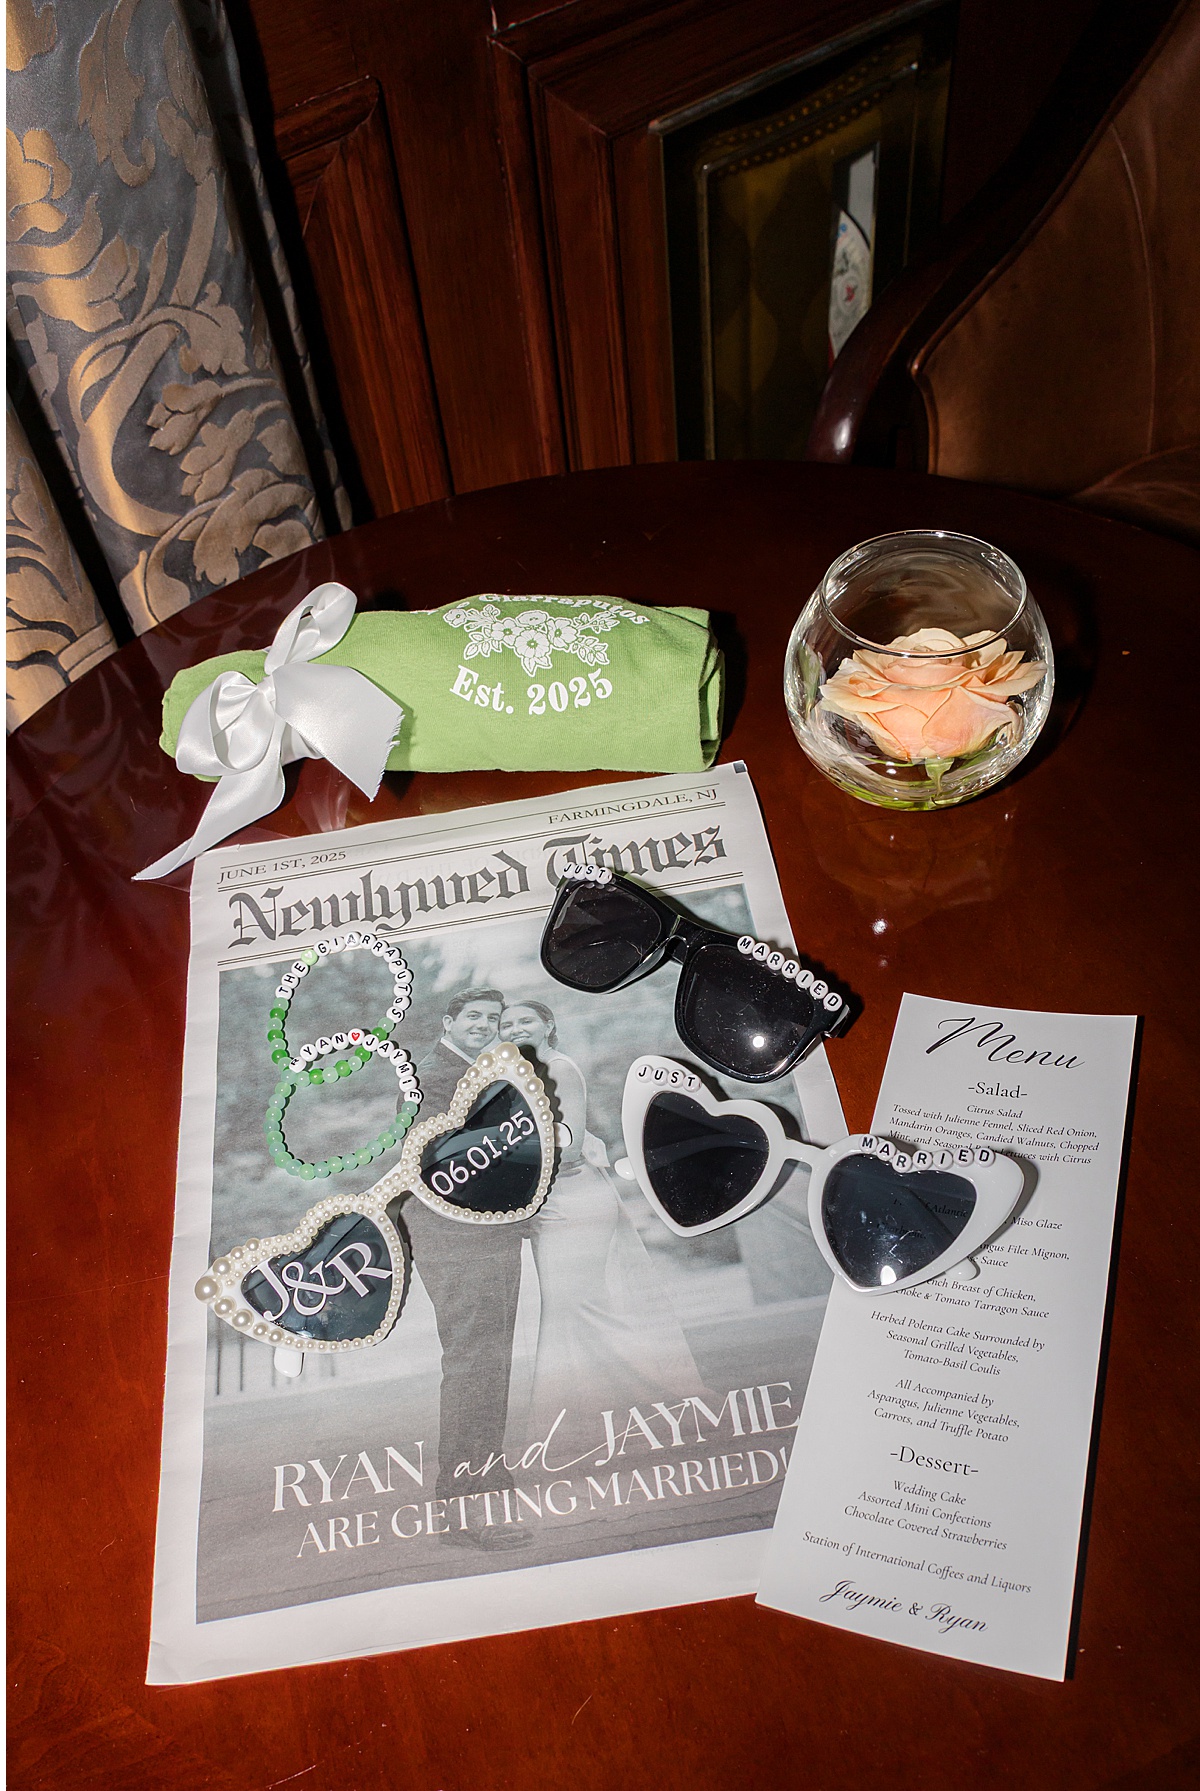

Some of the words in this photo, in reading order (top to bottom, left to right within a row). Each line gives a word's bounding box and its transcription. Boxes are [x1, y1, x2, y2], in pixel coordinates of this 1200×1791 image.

[449, 664, 514, 715] Est.
[526, 667, 613, 716] 2025
[548, 793, 693, 824] FARMINGDALE,
[696, 788, 718, 801] NJ
[217, 865, 267, 885] JUNE
[272, 858, 306, 872] 1ST,
[310, 851, 347, 866] 2025
[564, 864, 607, 880] JUST
[228, 849, 531, 949] Newlywed
[542, 825, 728, 889] Times
[279, 962, 306, 994] THE
[317, 933, 408, 1019] GIARRAPUTOS
[739, 937, 839, 1006] MARRIED
[926, 1017, 1085, 1069] Menu
[291, 1034, 345, 1066] RYAN
[365, 1036, 420, 1100] JAYMIE
[638, 1066, 696, 1087] JUST
[893, 1104, 921, 1117] Tossed
[923, 1109, 942, 1122] with
[943, 1112, 979, 1127] Julienne
[982, 1119, 1014, 1132] Fennel,
[1017, 1123, 1043, 1134] Sliced
[1046, 1126, 1064, 1136] Red
[1066, 1128, 1098, 1138] Onion,
[967, 1104, 994, 1115] Citrus
[997, 1108, 1022, 1119] Salad
[431, 1110, 535, 1195] 06.01.25
[861, 1137, 990, 1168] MARRIED
[888, 1129, 909, 1141] Mint,
[913, 1134, 930, 1146] and
[1039, 1152, 1059, 1163] with
[1060, 1154, 1091, 1164] Citrus
[889, 1118, 932, 1133] Mandarin
[935, 1124, 973, 1140] Oranges,
[976, 1131, 1014, 1146] Candied
[1017, 1136, 1055, 1149] Walnuts,
[1058, 1140, 1099, 1152] Chopped
[1011, 1217, 1034, 1229] Miso
[1036, 1219, 1062, 1229] Glaze
[980, 1243, 1005, 1253] ngus
[1007, 1244, 1031, 1256] Filet
[1031, 1247, 1069, 1261] Mignon,
[981, 1255, 1009, 1267] Sauce
[251, 1241, 394, 1323] J&R
[926, 1278, 949, 1288] ench
[951, 1281, 981, 1294] Breast
[983, 1286, 995, 1299] of
[995, 1287, 1036, 1302] Chicken,
[934, 1294, 971, 1309] Tomato
[974, 1300, 1019, 1316] Tarragon
[1021, 1306, 1049, 1319] Sauce
[871, 1311, 906, 1328] Herbed
[908, 1318, 944, 1335] Polenta
[946, 1325, 970, 1339] Cake
[973, 1329, 1030, 1348] Surrounded
[1032, 1339, 1045, 1352] by
[887, 1330, 928, 1346] Seasonal
[931, 1336, 964, 1354] Grilled
[967, 1345, 1019, 1363] Vegetables,
[903, 1349, 967, 1371] Tomato-Basil
[968, 1362, 1001, 1375] Coulis
[868, 1389, 920, 1410] Asparagus,
[922, 1402, 964, 1418] Julienne
[968, 1408, 1019, 1427] Vegetables,
[896, 1380, 912, 1390] All
[912, 1384, 979, 1406] Accompanied
[981, 1394, 994, 1408] by
[874, 1405, 912, 1424] Carrots,
[916, 1417, 936, 1429] and
[939, 1419, 972, 1438] Truffle
[976, 1426, 1009, 1443] Potato
[271, 1440, 425, 1512] RYAN
[595, 1381, 800, 1467] JAYMIE
[890, 1446, 978, 1475] -Dessert-
[858, 1492, 903, 1511] Assorted
[904, 1499, 930, 1515] Mini
[932, 1506, 991, 1528] Confections
[894, 1480, 938, 1502] Wedding
[940, 1492, 966, 1507] Cake
[297, 1511, 381, 1558] ARE
[391, 1479, 579, 1540] GETTING
[845, 1503, 894, 1526] Chocolate
[897, 1518, 940, 1536] Covered
[941, 1528, 1007, 1550] Strawberries
[803, 1531, 839, 1550] Station
[842, 1543, 856, 1556] of
[856, 1546, 925, 1571] International
[928, 1564, 964, 1580] Coffees
[967, 1571, 988, 1586] and
[991, 1576, 1031, 1593] Liquors
[819, 1580, 902, 1612] Jaymie
[908, 1602, 923, 1616] &
[925, 1604, 986, 1633] Ryan
